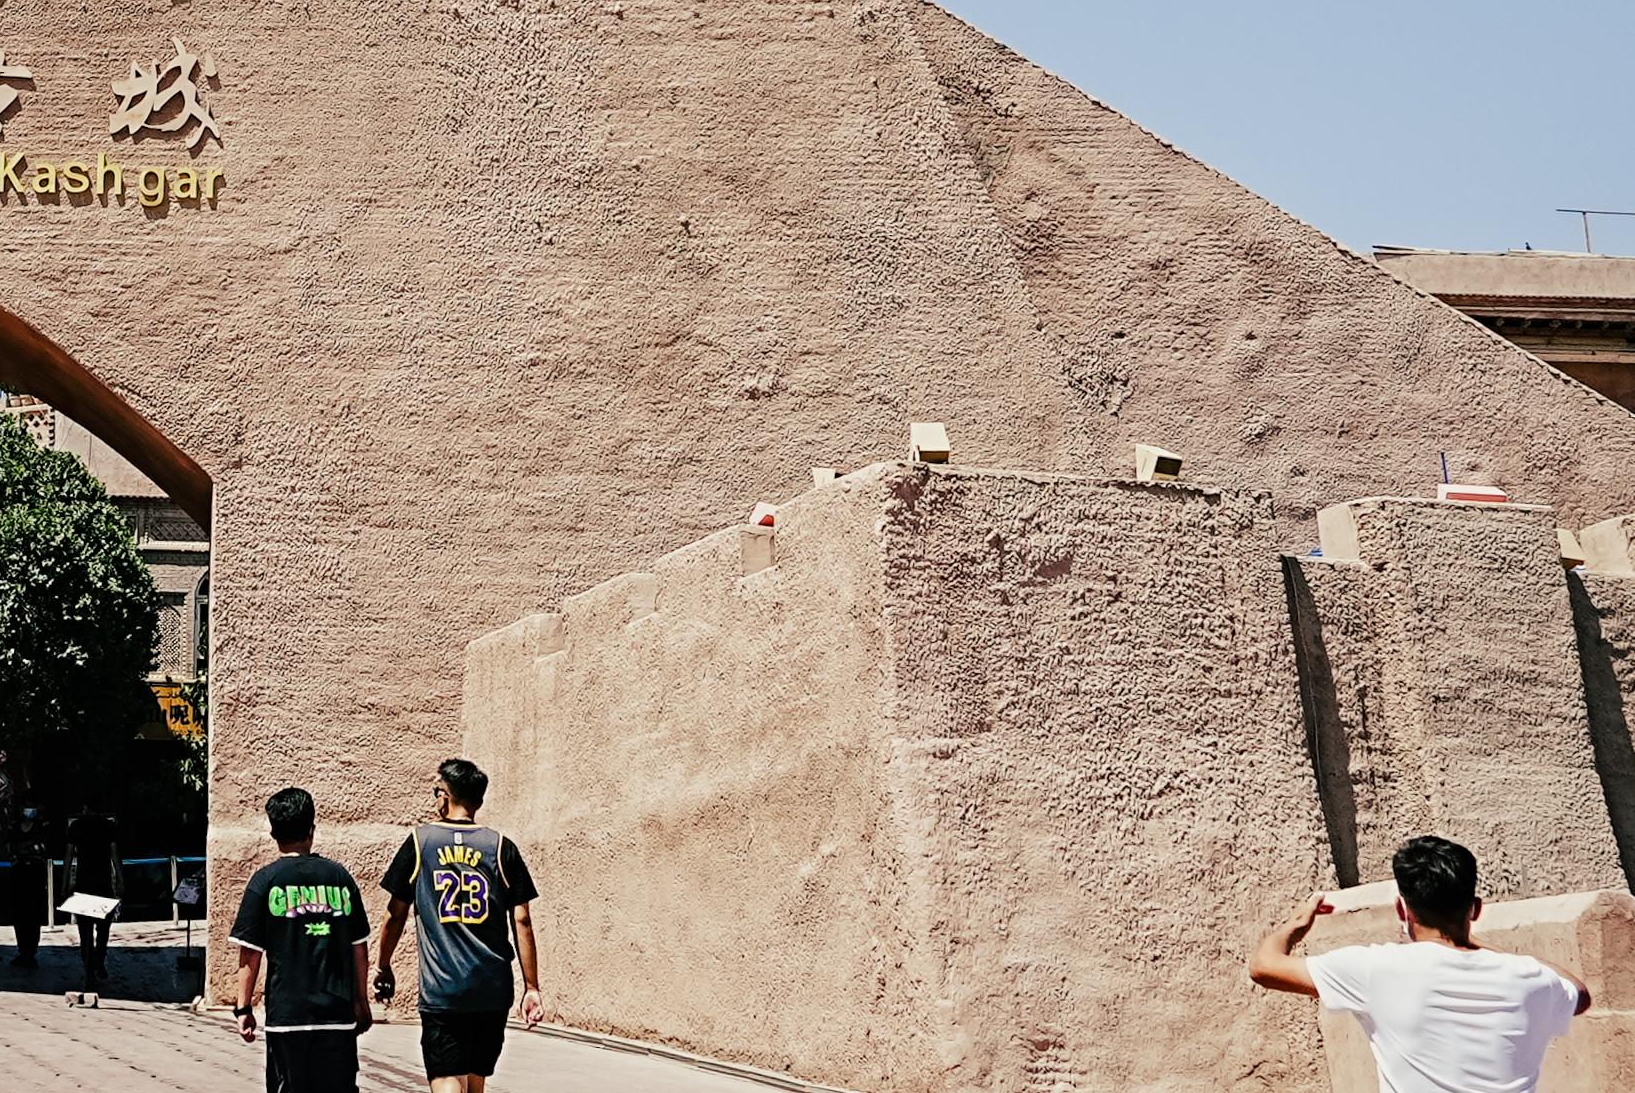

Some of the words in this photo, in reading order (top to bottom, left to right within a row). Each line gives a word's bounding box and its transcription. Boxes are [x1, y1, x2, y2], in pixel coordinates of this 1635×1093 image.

[437, 845, 483, 867] JAMES
[268, 885, 352, 918] GENIUS
[432, 870, 490, 924] 23
